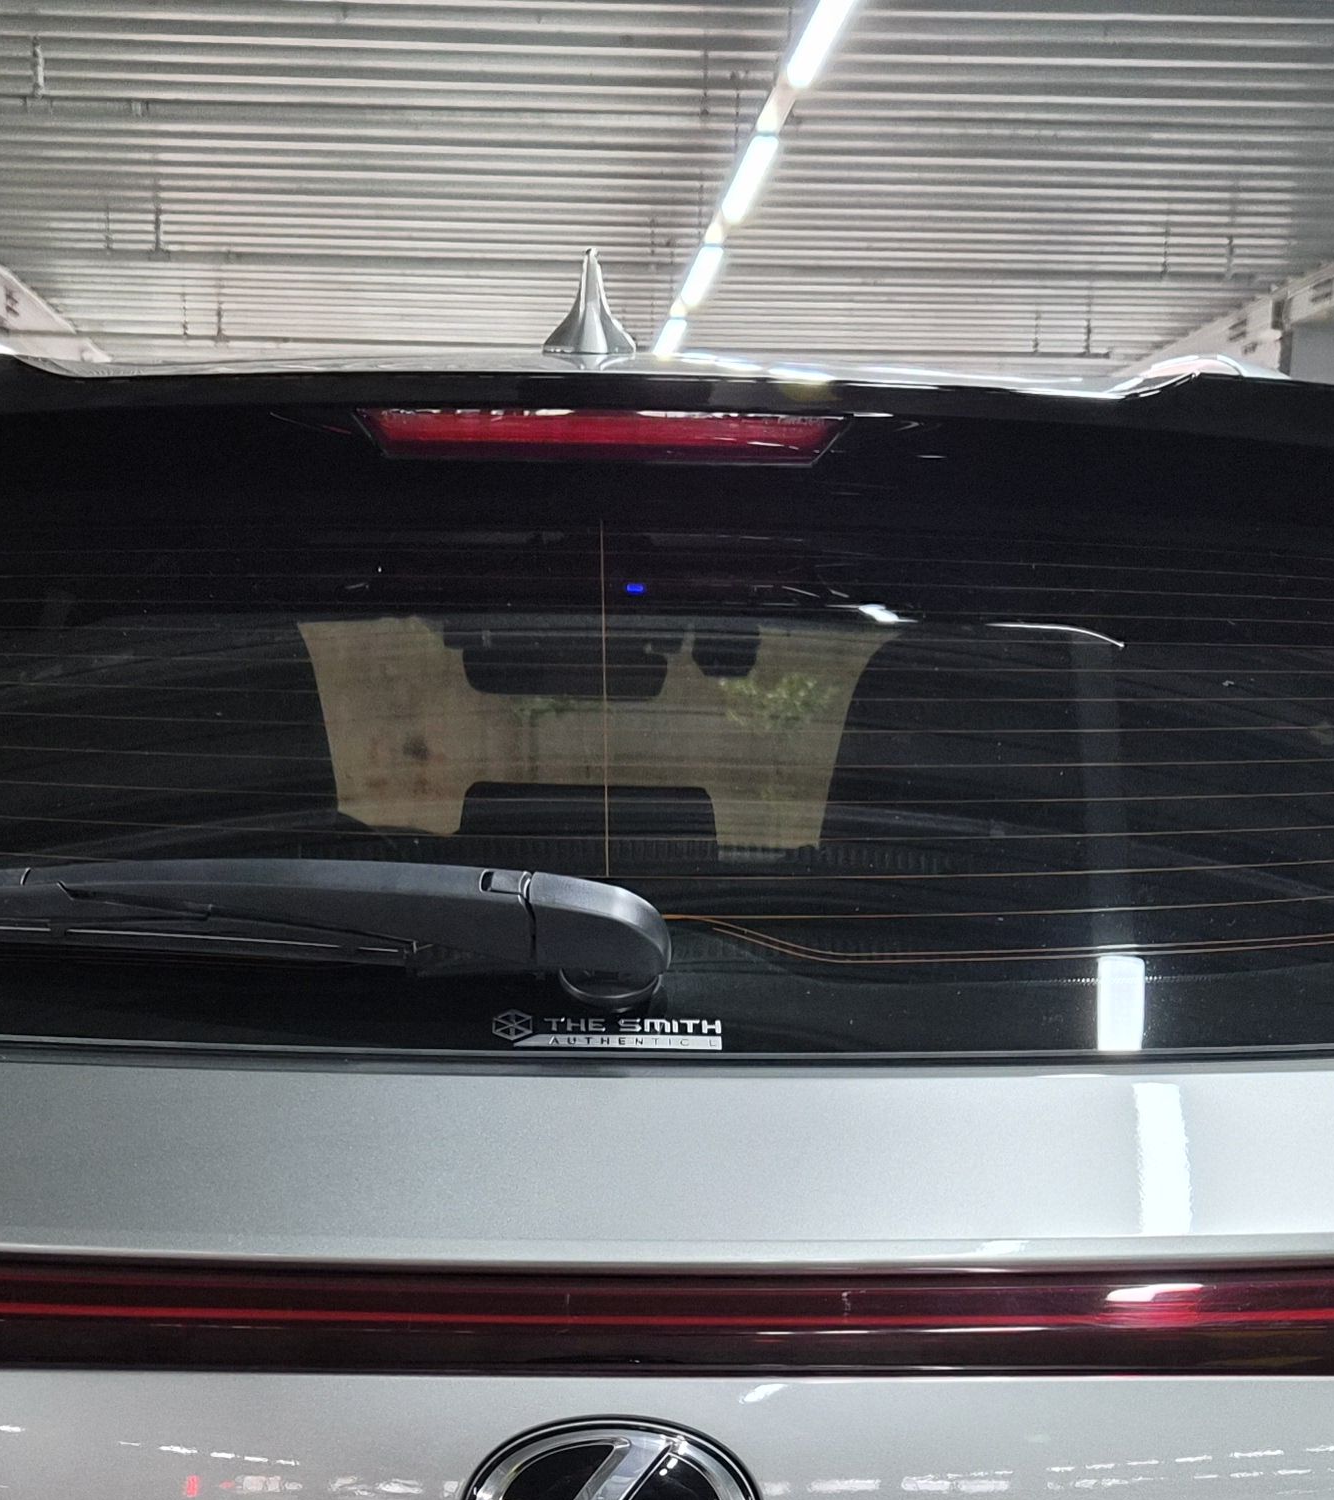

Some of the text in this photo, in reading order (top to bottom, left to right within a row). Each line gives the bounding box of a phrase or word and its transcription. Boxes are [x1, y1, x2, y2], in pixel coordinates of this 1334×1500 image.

[543, 1017, 723, 1035] THE SMITH
[549, 1036, 691, 1048] AUTHENTIC
